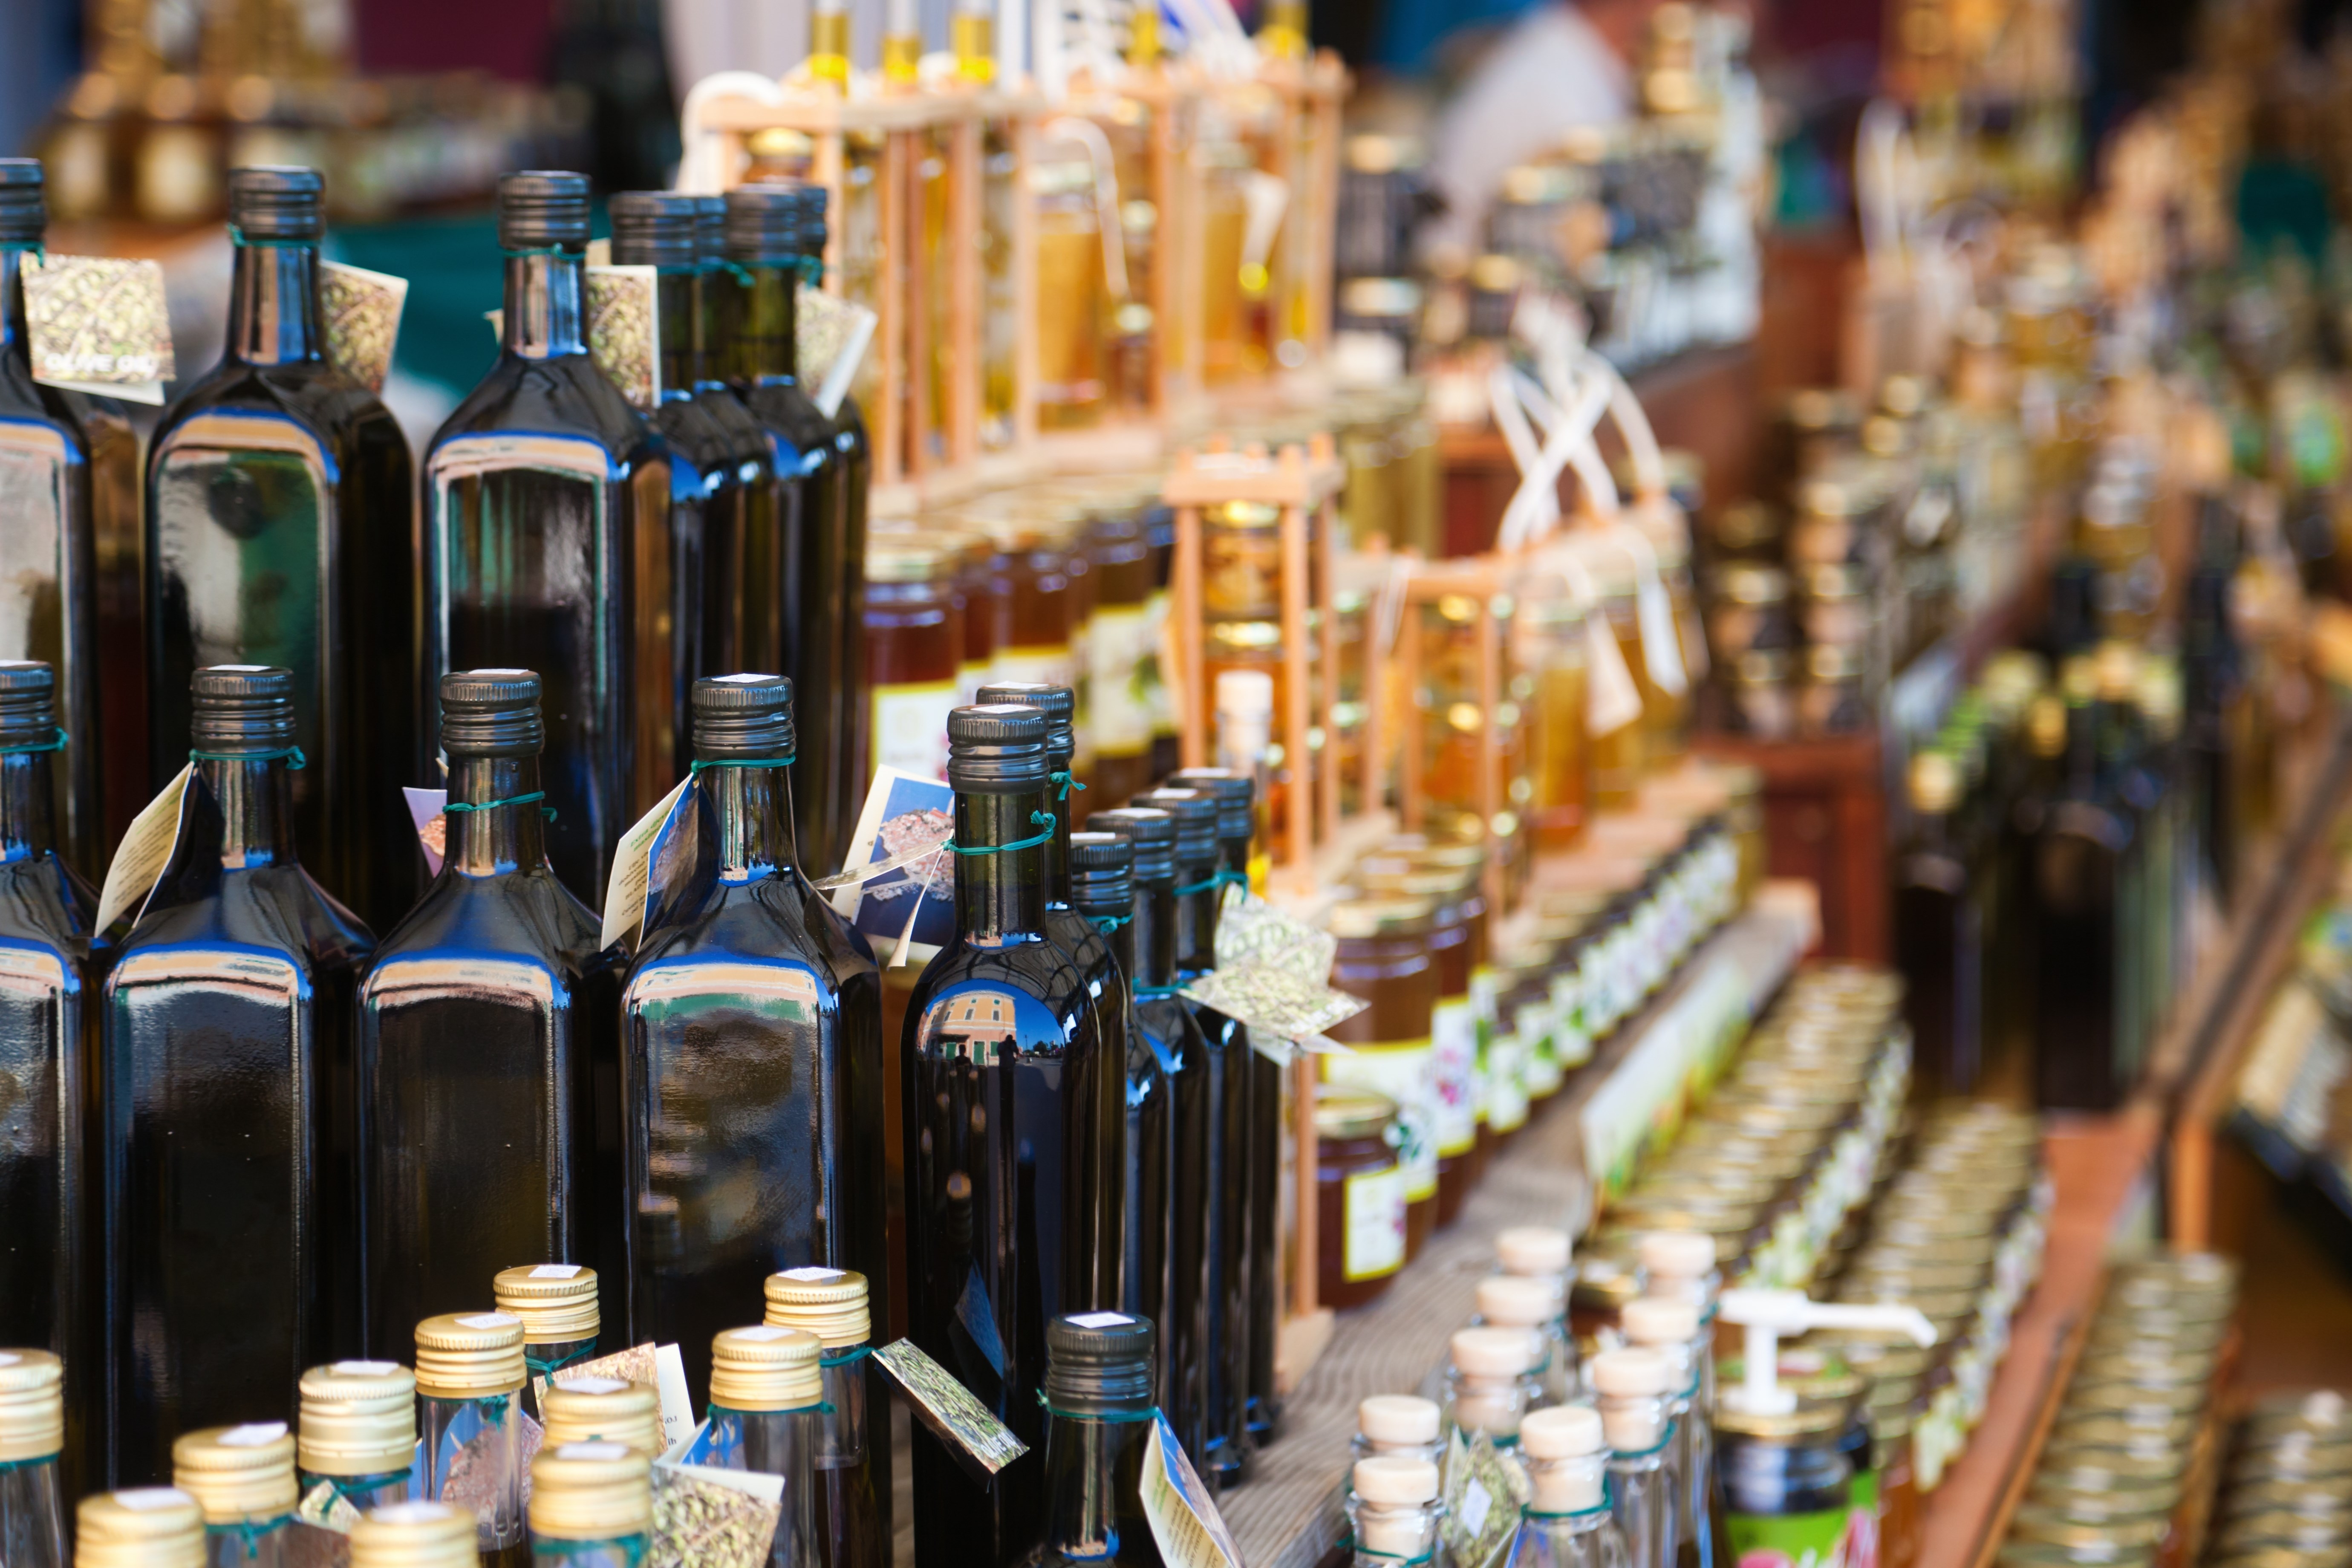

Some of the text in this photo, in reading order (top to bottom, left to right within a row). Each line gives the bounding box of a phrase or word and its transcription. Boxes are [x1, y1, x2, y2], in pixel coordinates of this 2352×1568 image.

[44, 352, 154, 374] OLIVE OIL
[630, 828, 648, 847] Extra
[980, 1431, 1017, 1459] OLIVE OIL
